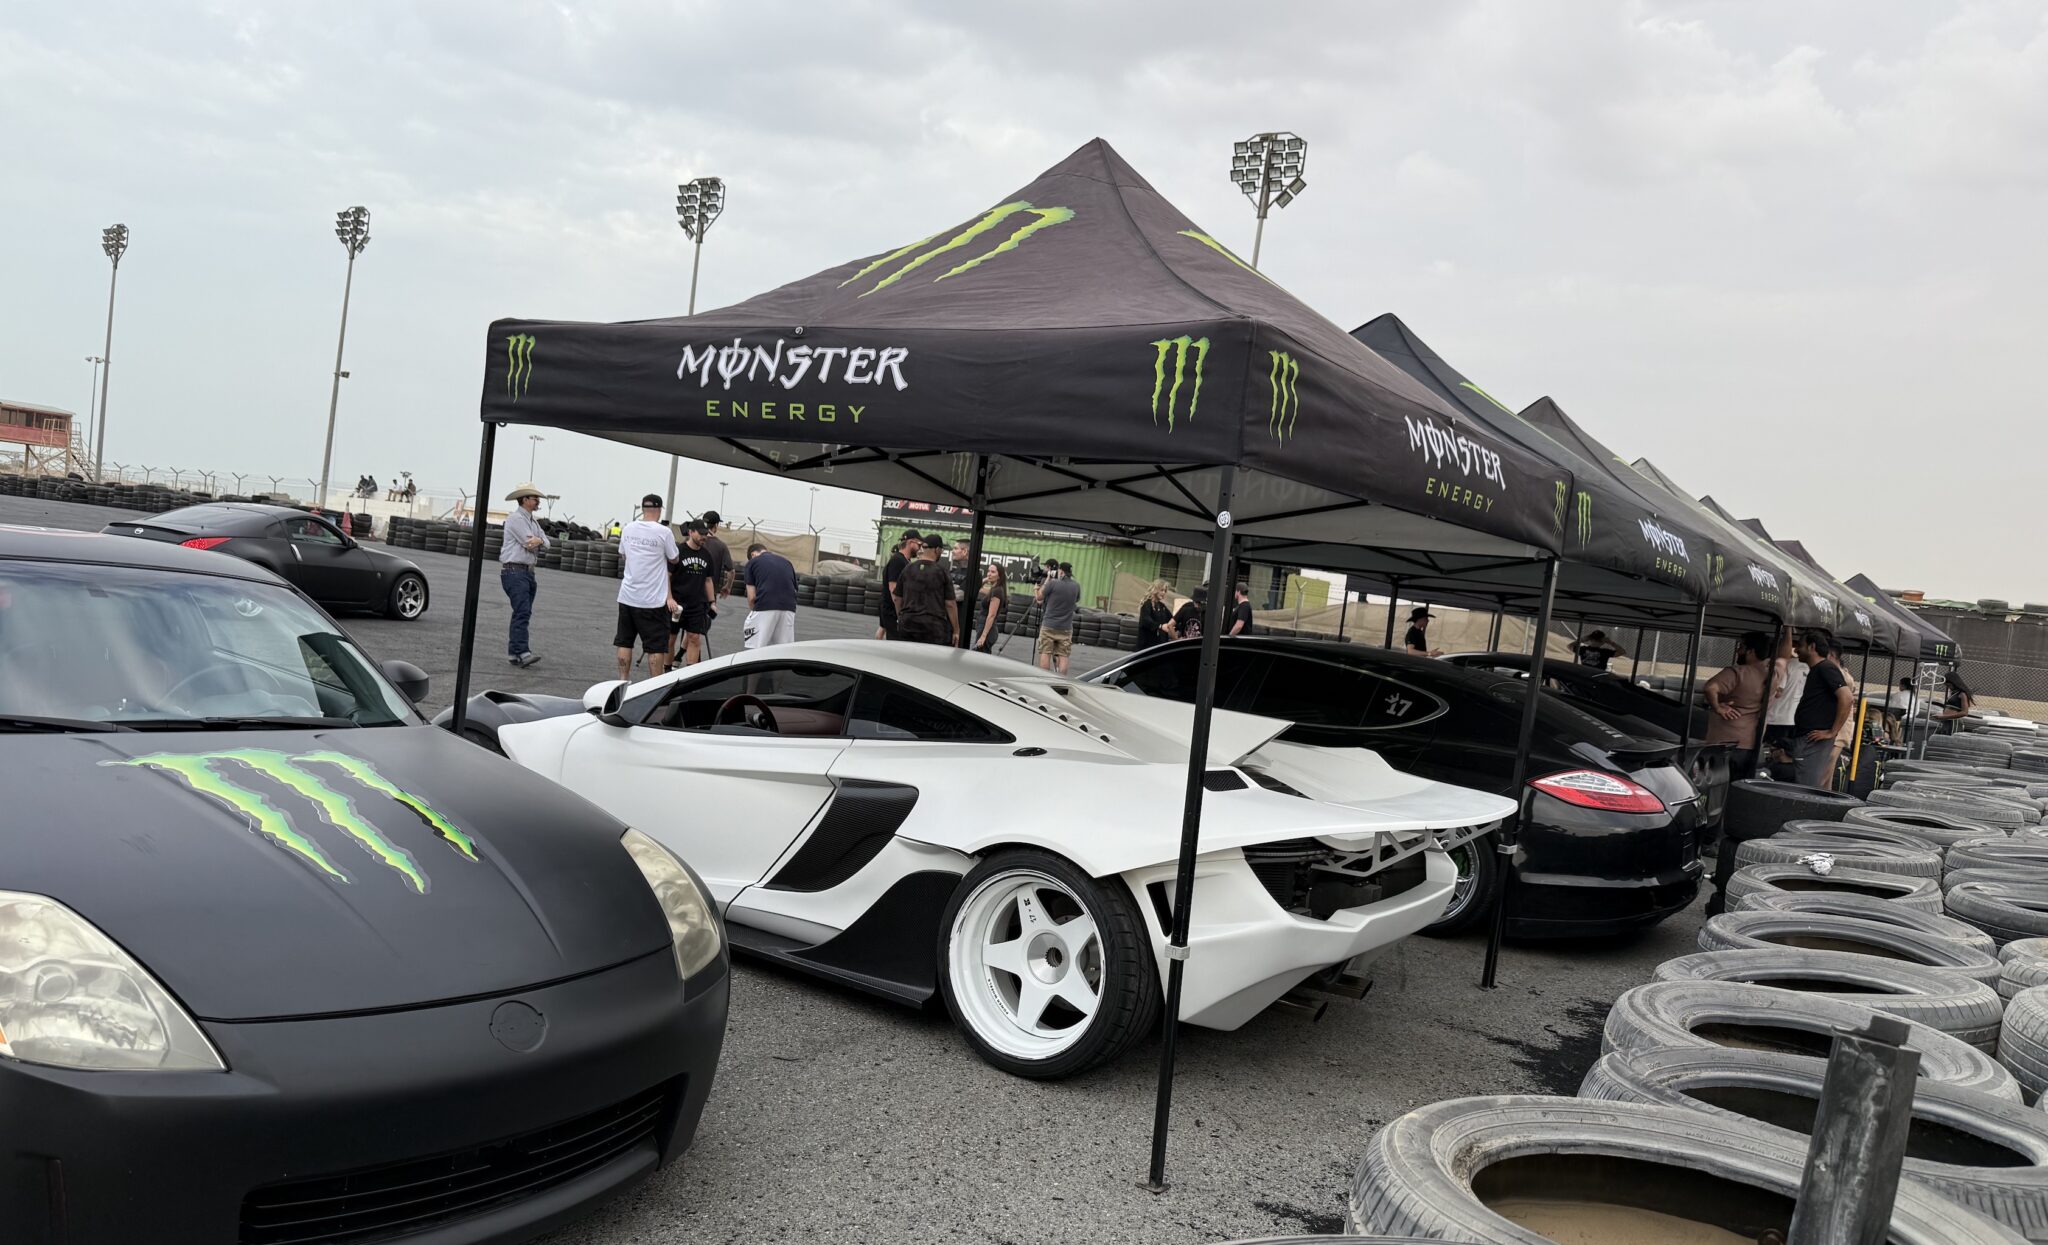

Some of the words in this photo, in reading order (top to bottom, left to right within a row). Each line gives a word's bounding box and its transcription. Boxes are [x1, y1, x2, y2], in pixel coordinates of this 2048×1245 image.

[676, 337, 909, 392] MONSTER
[706, 400, 866, 424] ENERGY
[1404, 414, 1506, 491] MONSTER
[909, 501, 930, 511] MOTUL
[1425, 477, 1493, 513] ENERGY
[1655, 556, 1687, 578] ENERGY
[1385, 699, 1413, 717] 17
